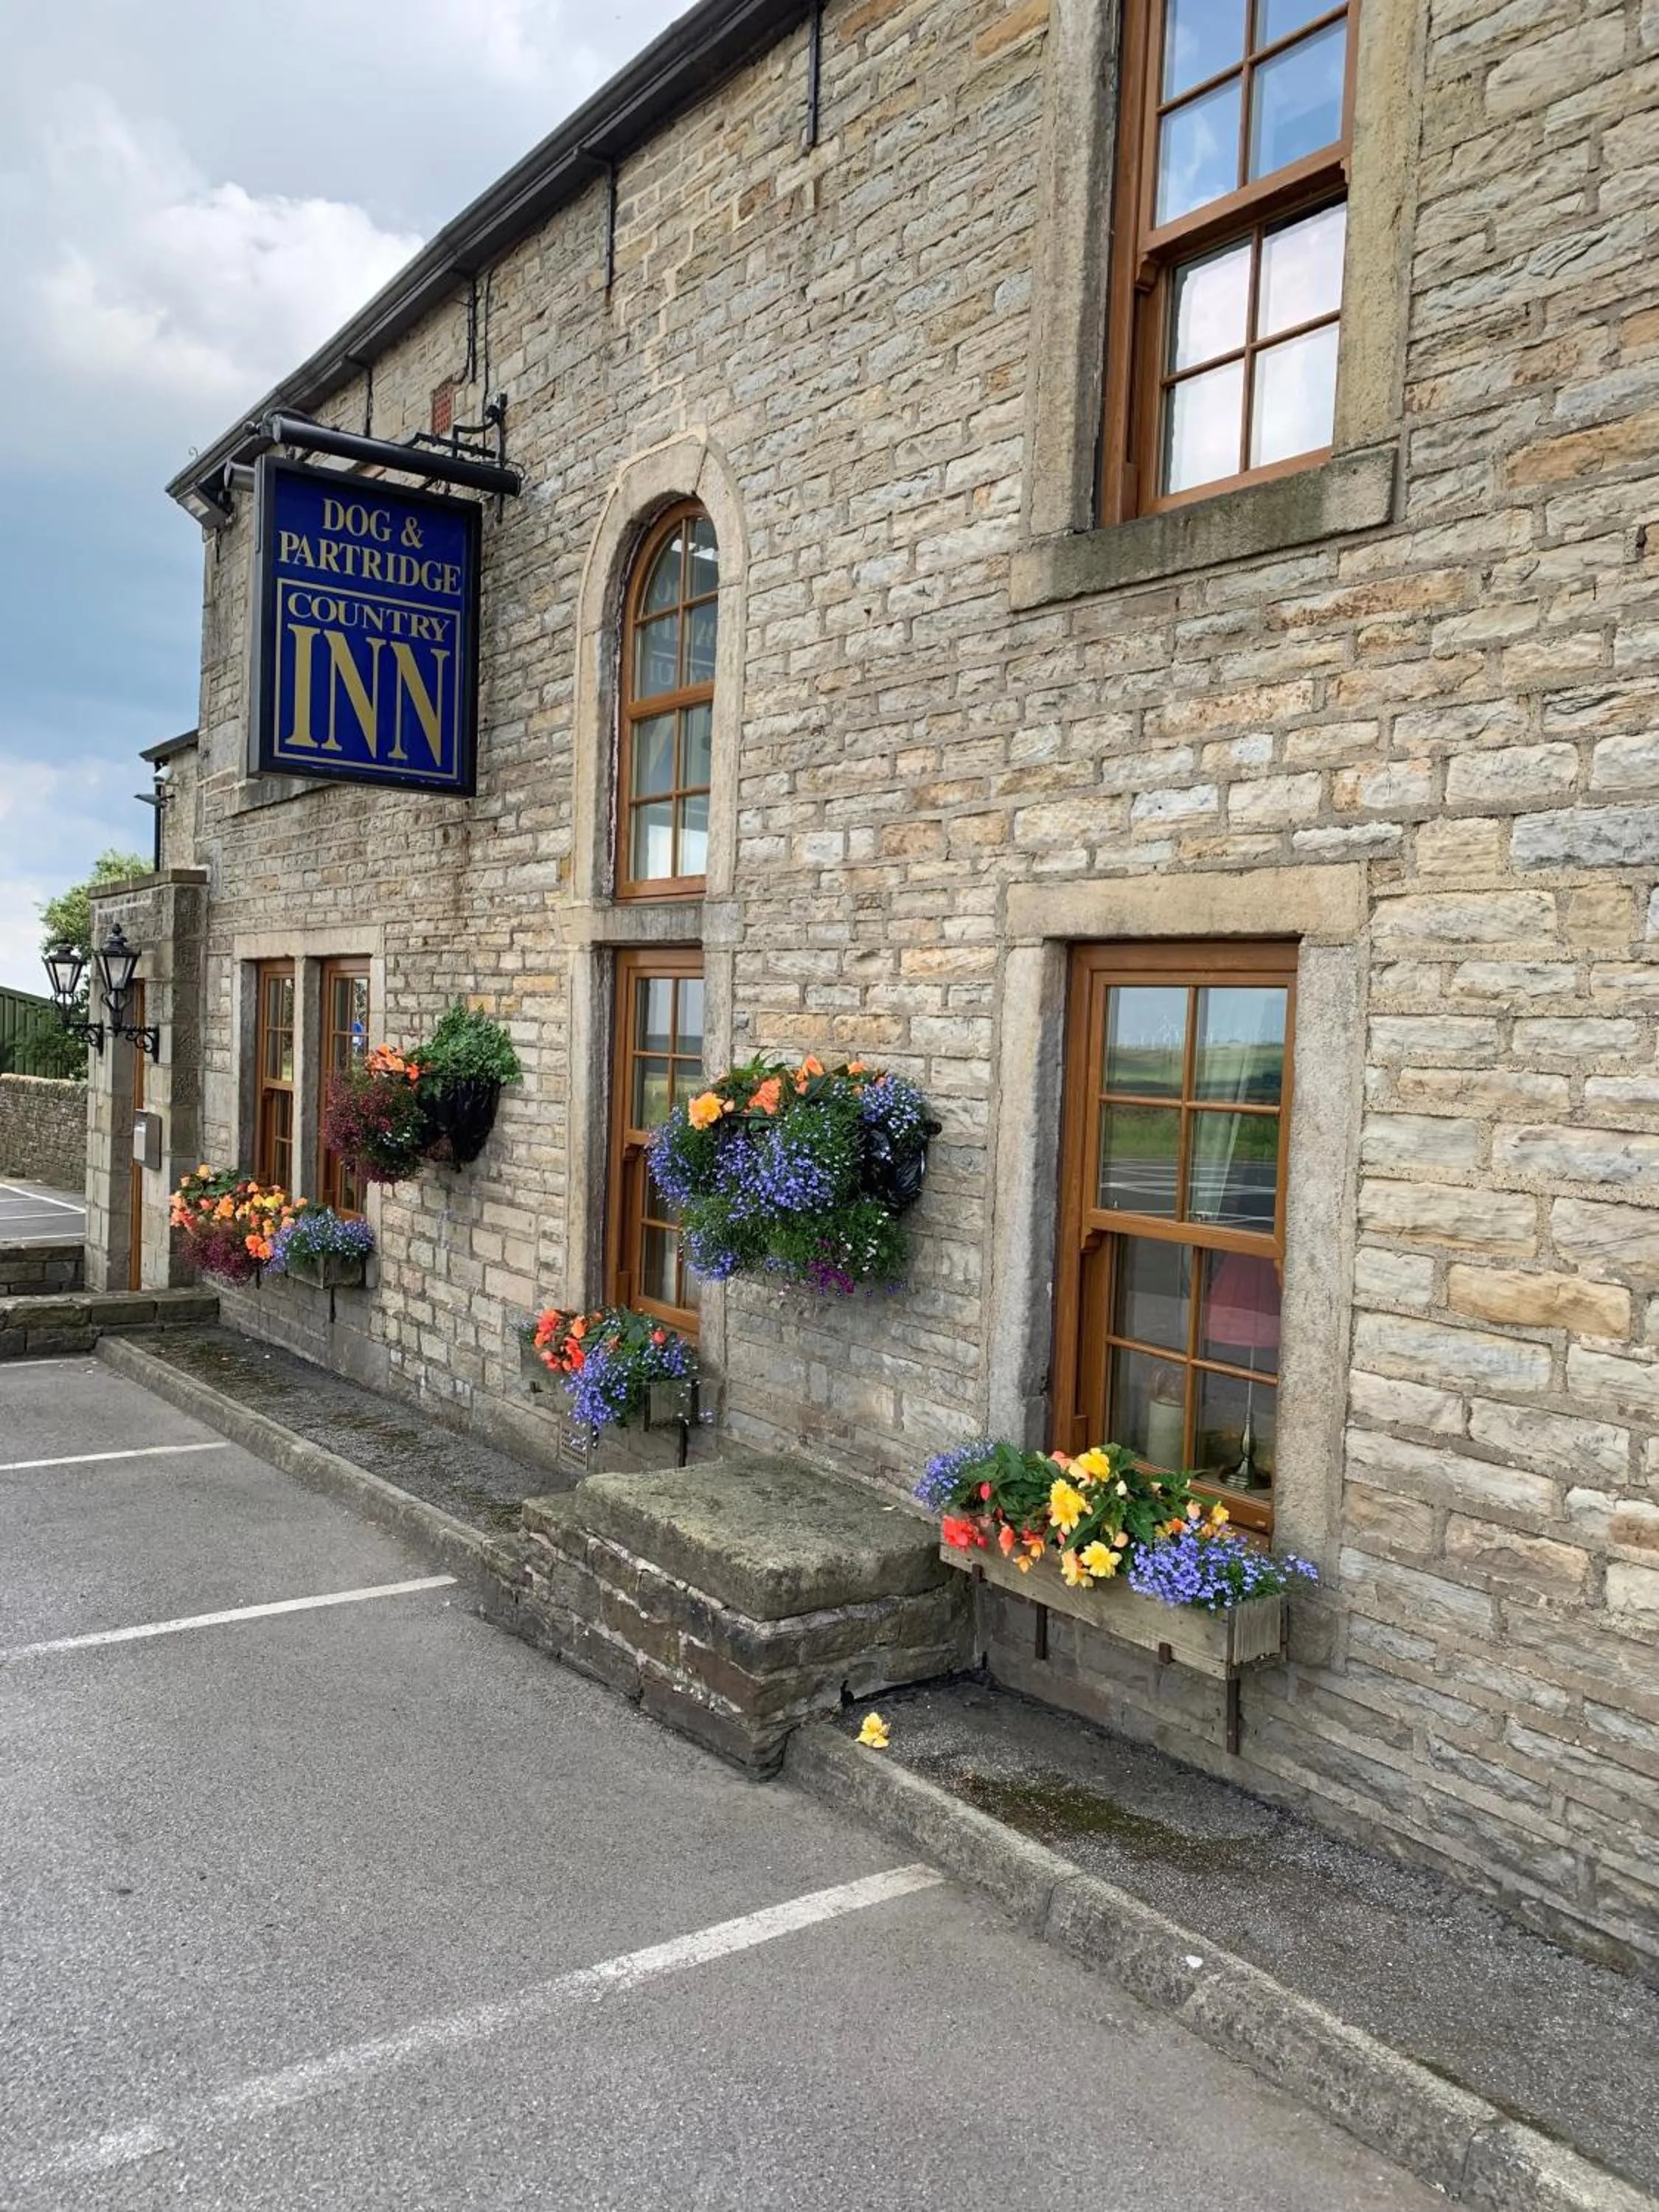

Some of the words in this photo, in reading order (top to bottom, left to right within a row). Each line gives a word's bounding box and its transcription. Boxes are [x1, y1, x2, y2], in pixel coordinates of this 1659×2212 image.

[322, 498, 393, 542] DOG
[400, 516, 424, 549] &
[277, 529, 462, 596] PARTRIDGE
[287, 592, 451, 642] COUNTRY
[284, 622, 451, 768] INN
